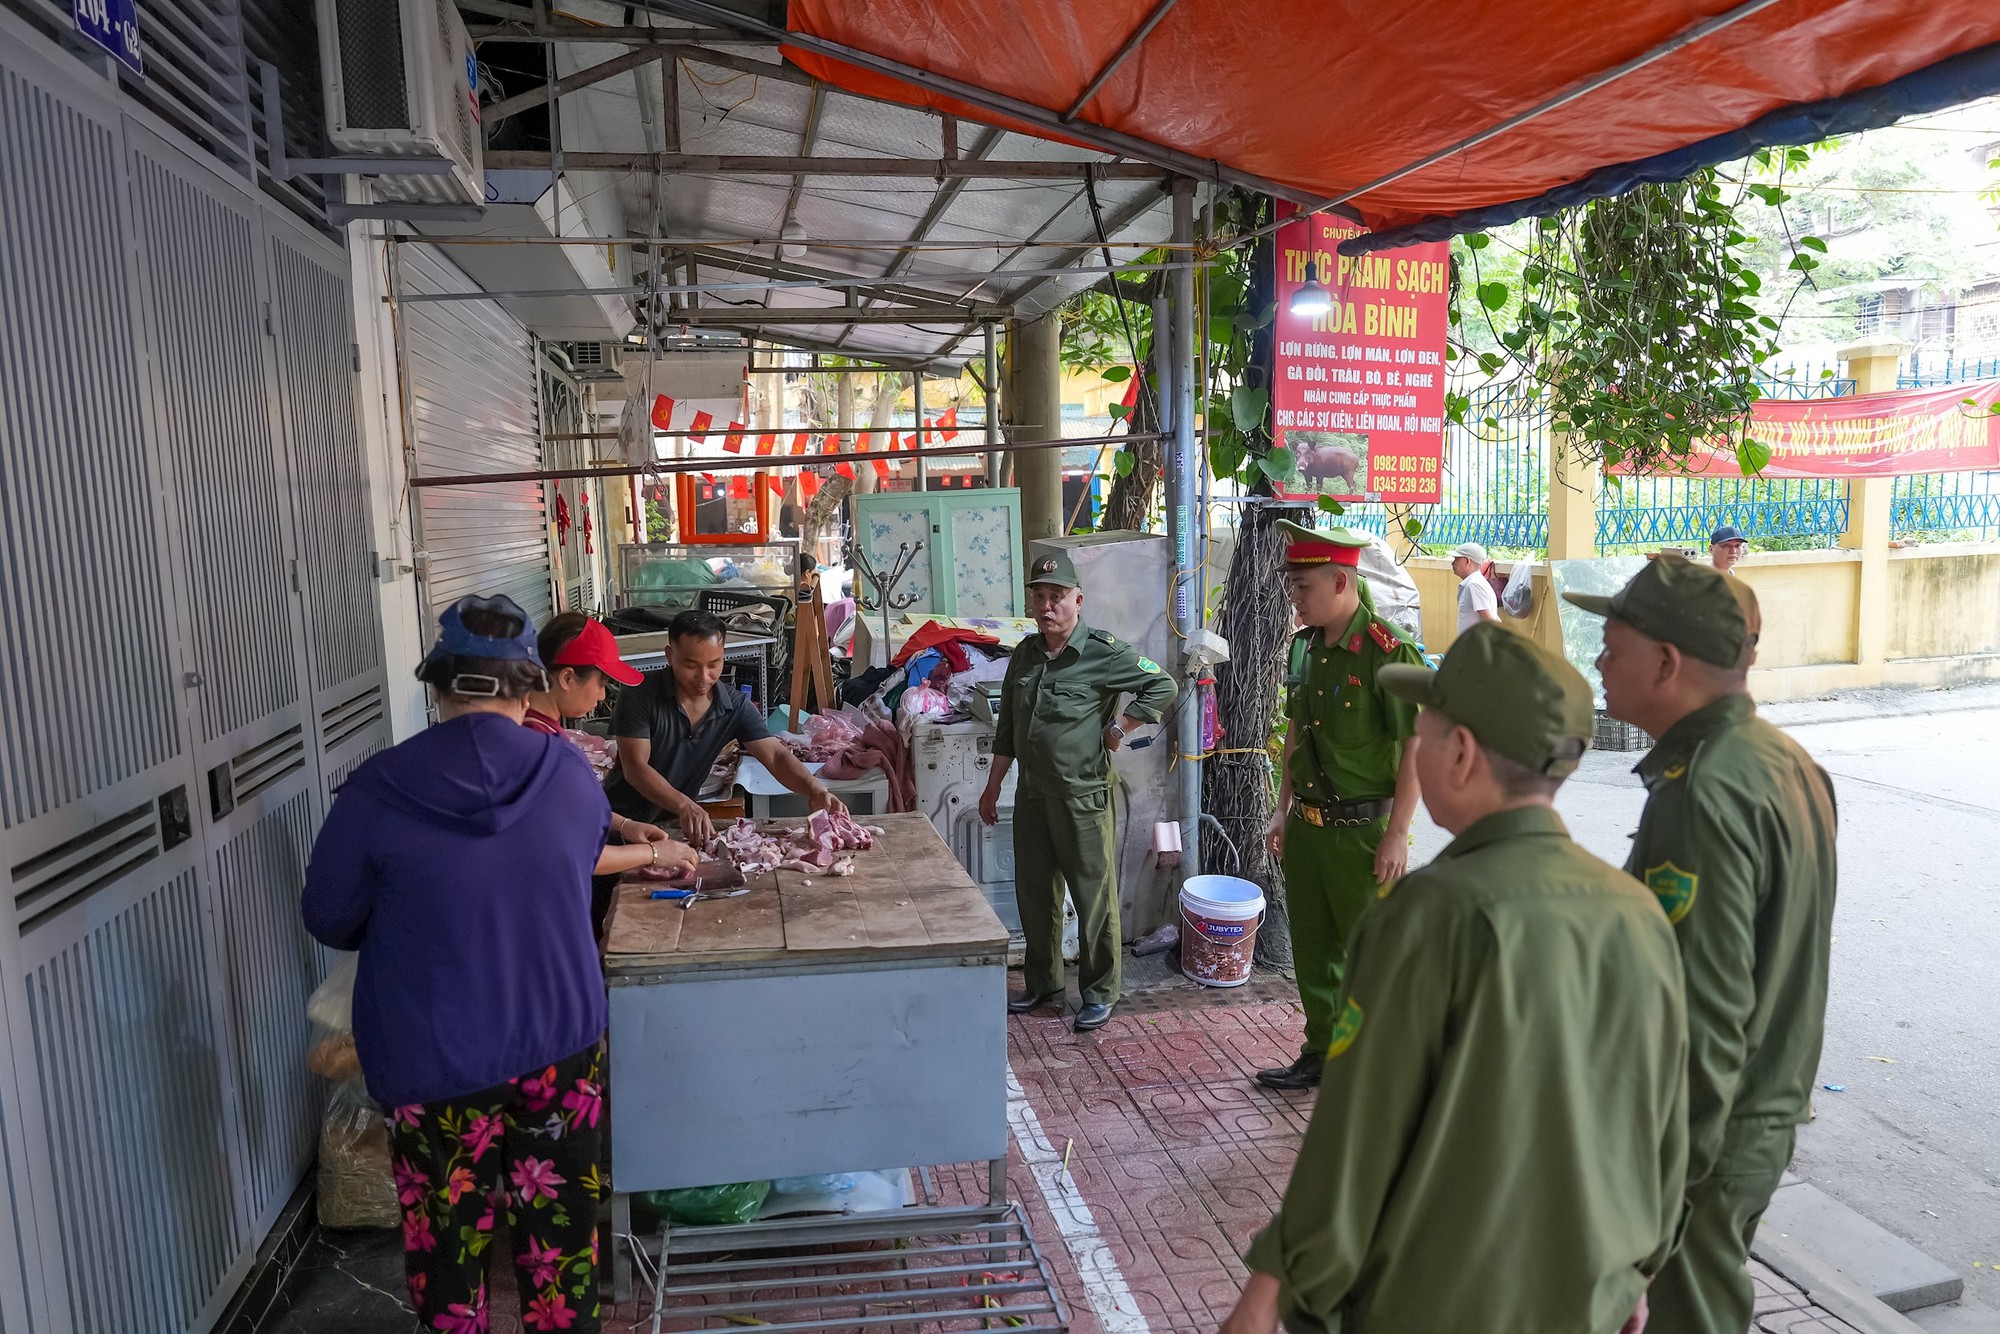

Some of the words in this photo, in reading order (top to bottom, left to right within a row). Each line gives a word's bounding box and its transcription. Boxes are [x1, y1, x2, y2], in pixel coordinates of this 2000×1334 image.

[1396, 258, 1444, 299] SẠCH
[1364, 297, 1418, 338] BÌNH
[1280, 340, 1301, 359] LỢN
[1304, 341, 1338, 361] RỪNG,
[1341, 344, 1363, 362] LỢN
[1365, 345, 1392, 364] MÁN,
[1395, 347, 1416, 367] LỢN
[1418, 350, 1441, 367] ĐEN,
[1287, 364, 1303, 381] GÀ
[1306, 362, 1328, 383] ĐỒI,
[1331, 367, 1363, 385] TRÂU,
[1365, 368, 1383, 386] BÒ,
[1386, 370, 1402, 387] BÊ,
[1405, 372, 1434, 388] NGHÉ
[1304, 387, 1327, 408] NHẬN
[1329, 391, 1351, 405] CUNG
[1353, 387, 1370, 406] CẤP
[1371, 393, 1392, 410] THỰC
[1394, 388, 1417, 408] PHẨM
[1276, 409, 1295, 427] CHO
[1296, 407, 1315, 427] CÁC
[1316, 410, 1329, 432] SỰ
[1331, 409, 1354, 434] KIỆN:
[1356, 411, 1373, 431] LIÊN
[1377, 414, 1402, 433] HOAN,
[1404, 413, 1418, 435] HỘI
[1420, 417, 1441, 437] NGHỊ
[1373, 455, 1397, 471] 0982
[1399, 455, 1417, 472] 003
[1419, 456, 1437, 473] 769
[1373, 476, 1397, 492] 0345
[1399, 476, 1417, 493] 239
[1419, 477, 1436, 494] 236
[1207, 925, 1244, 933] JUBYTEX
